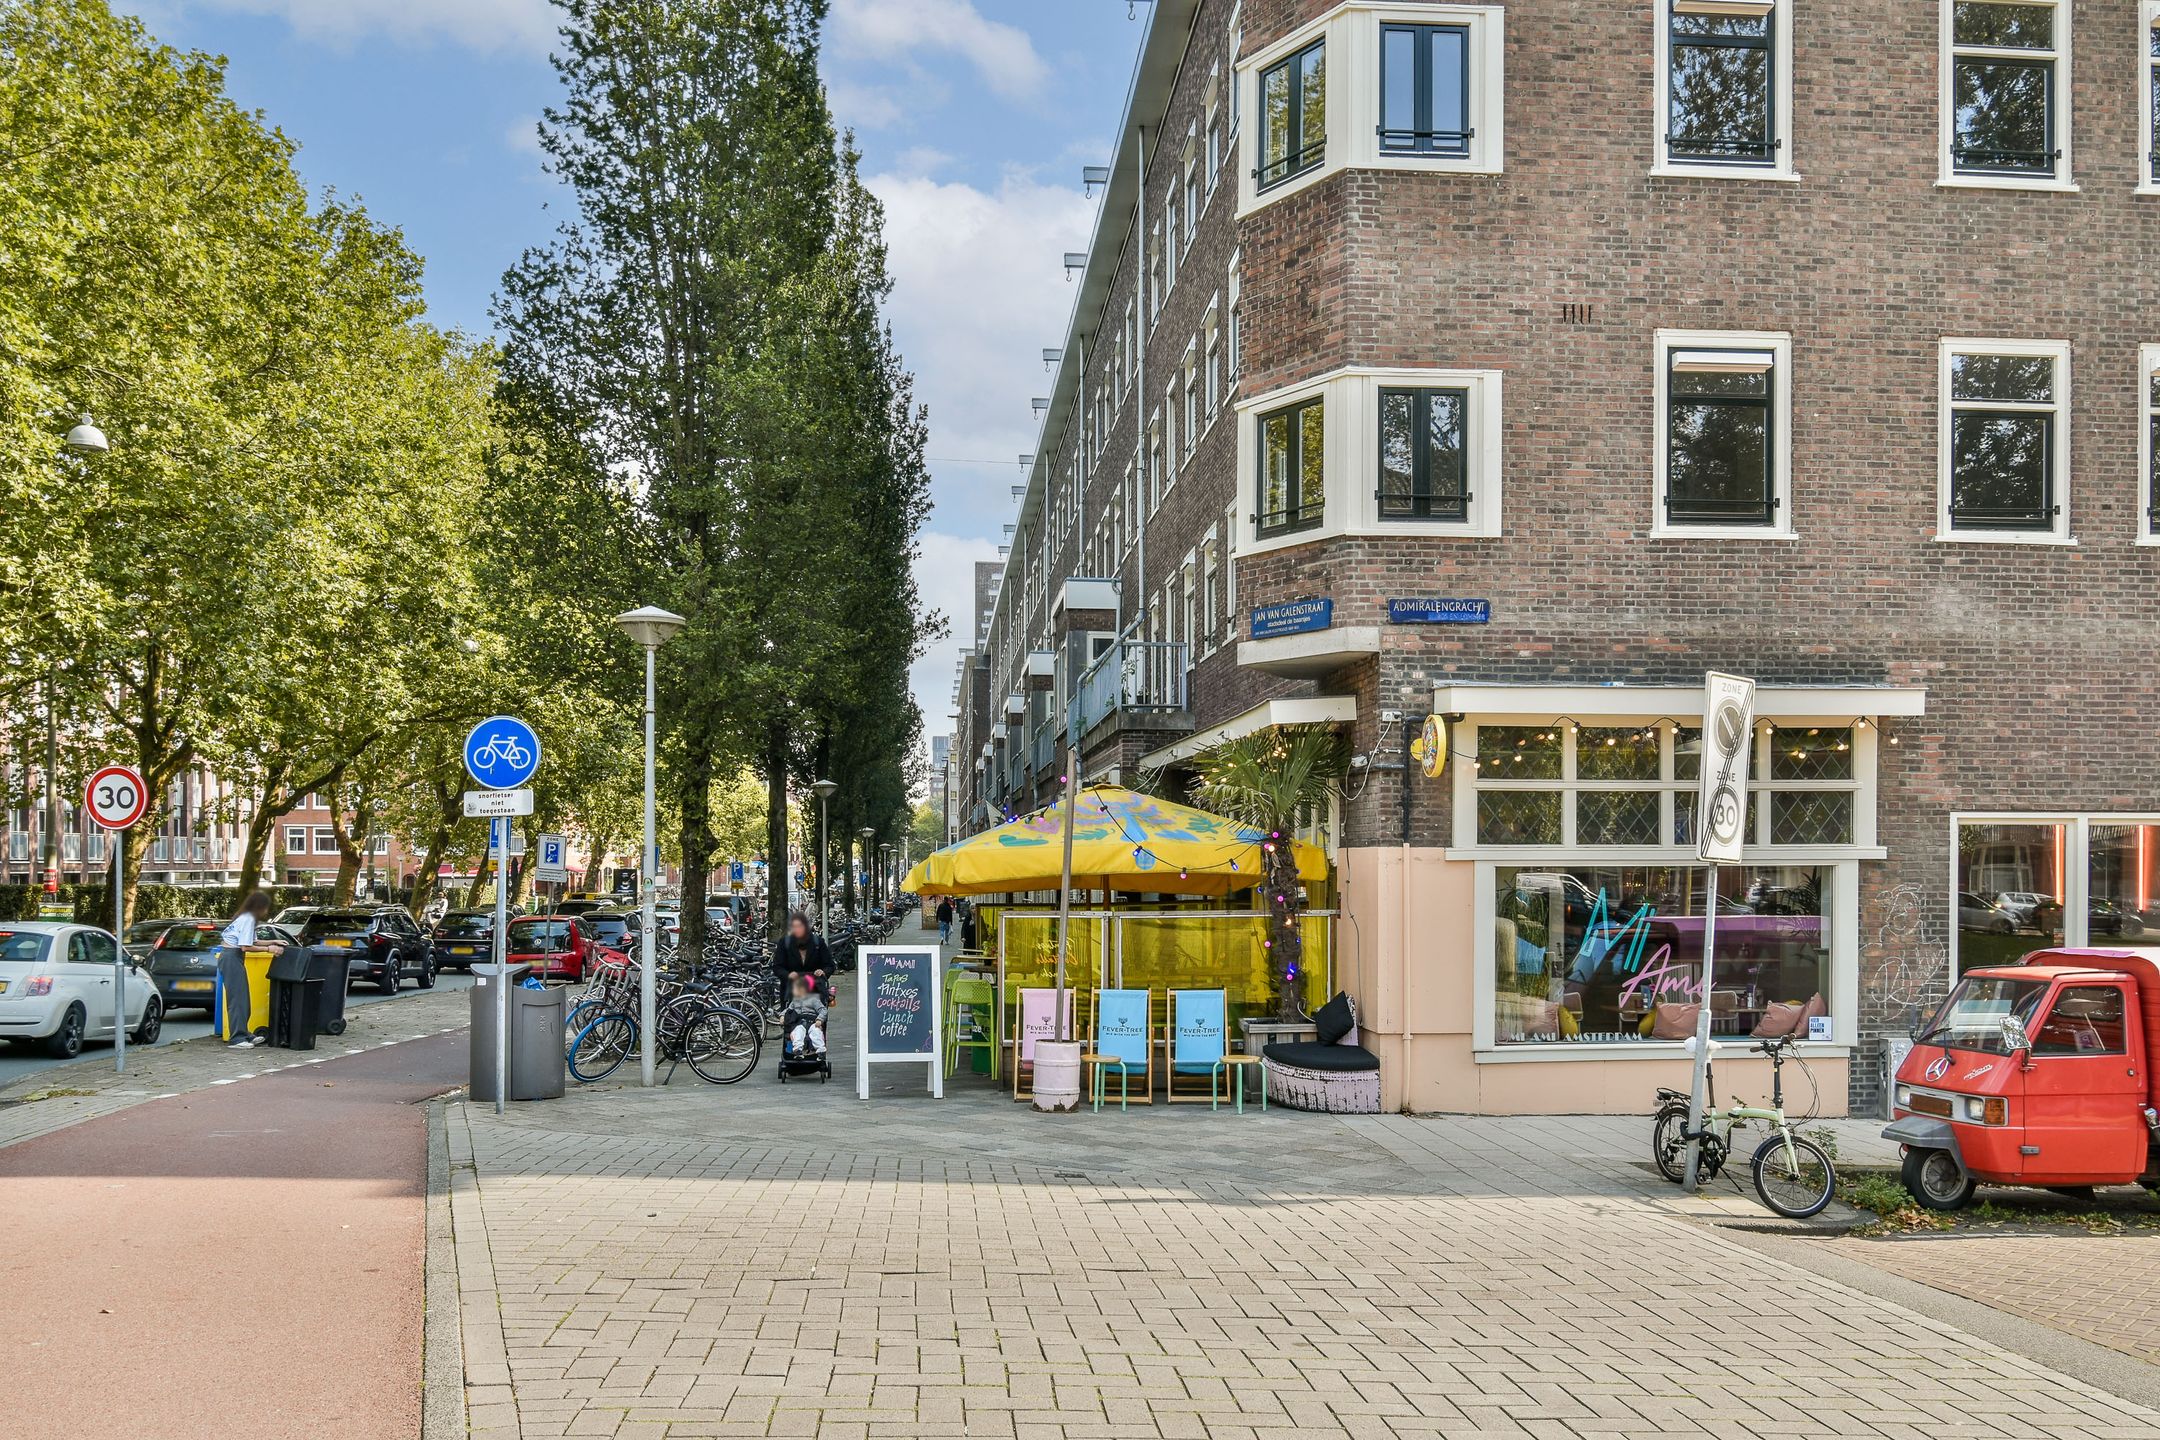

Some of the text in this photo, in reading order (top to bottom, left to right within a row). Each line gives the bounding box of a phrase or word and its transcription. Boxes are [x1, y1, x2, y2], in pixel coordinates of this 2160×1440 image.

[1254, 602, 1324, 624] JAN VAN GALENSTRAAT
[1393, 602, 1485, 615] ADMIRALENGRACHT
[1722, 682, 1742, 695] ZONE
[97, 786, 134, 809] 30
[1715, 804, 1736, 827] 30
[548, 844, 556, 854] P
[733, 863, 740, 872] P
[876, 997, 920, 1012] Cocktails
[882, 1010, 914, 1024] Lunch
[880, 1022, 908, 1036] Coffee
[1510, 1032, 1643, 1042] MI AMI AMSTERDAM
